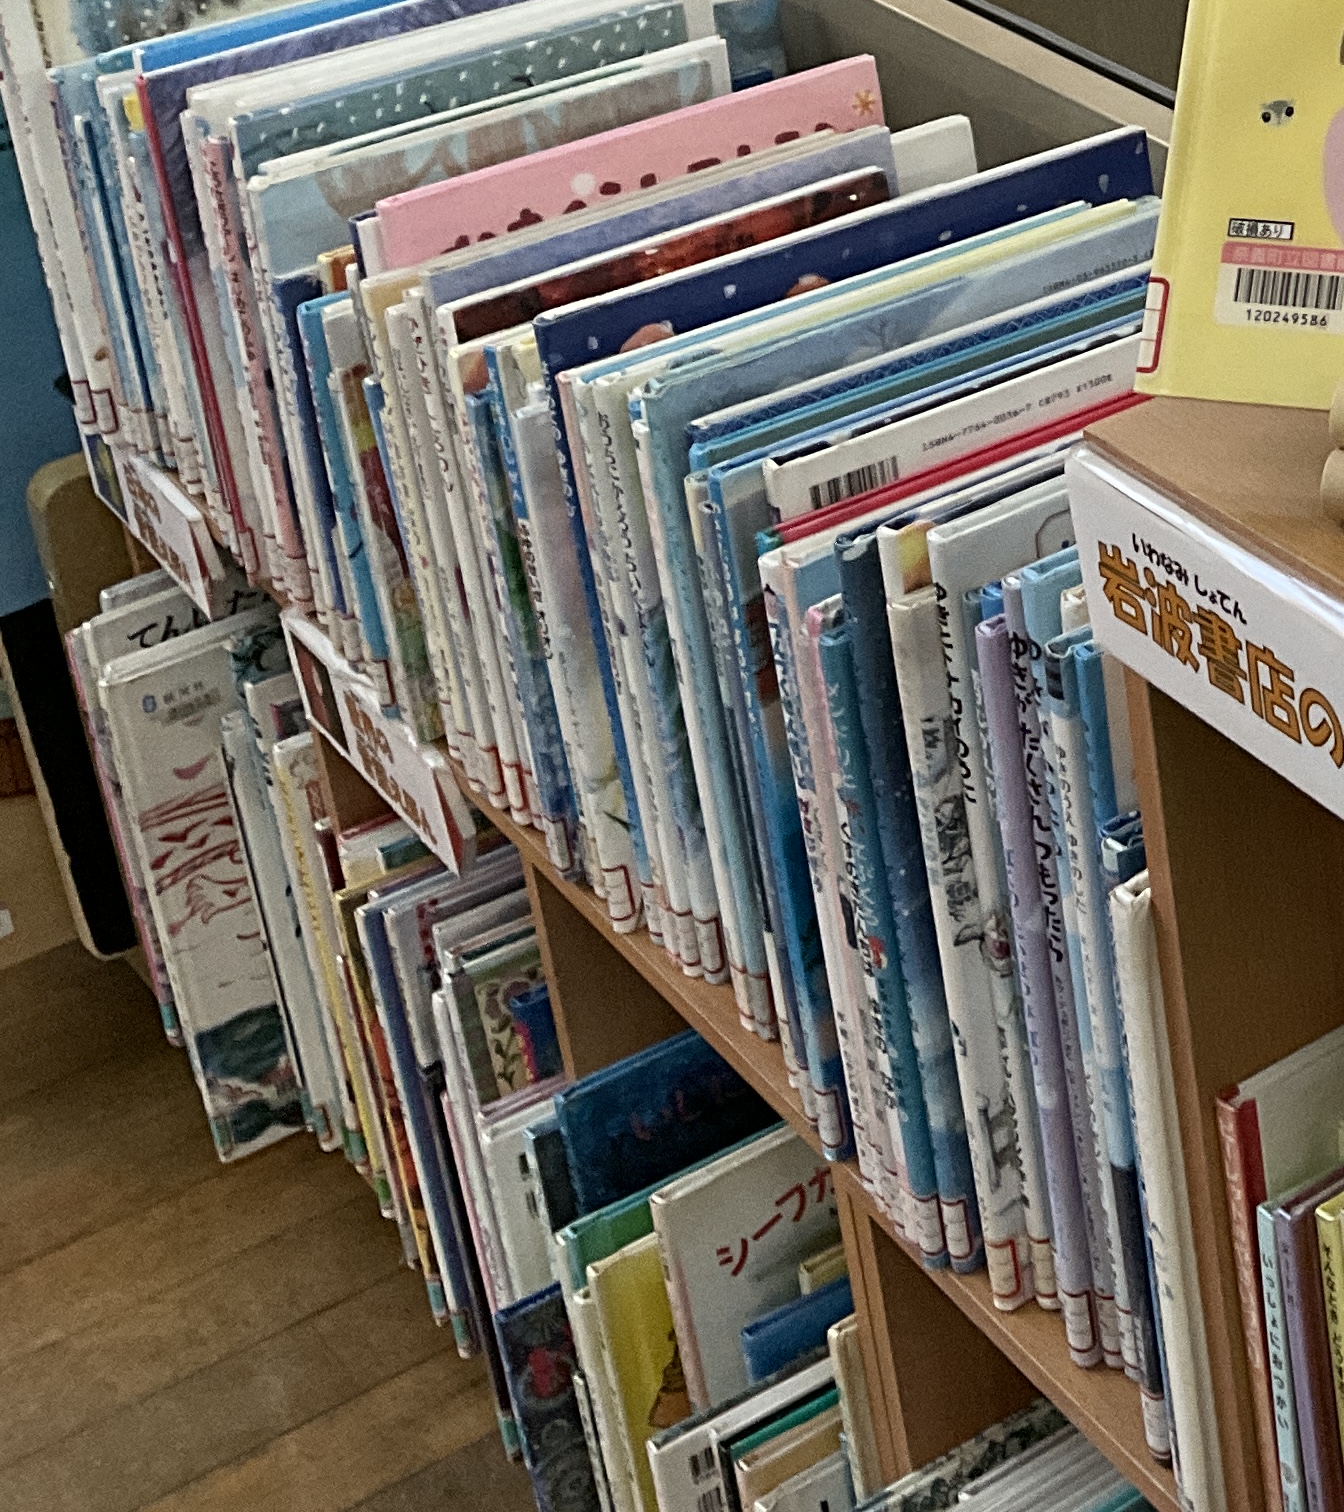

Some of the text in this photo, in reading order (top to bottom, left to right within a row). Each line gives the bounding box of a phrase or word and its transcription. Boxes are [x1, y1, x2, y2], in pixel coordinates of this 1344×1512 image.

[1246, 308, 1328, 327] 120249586
[1131, 532, 1248, 626] いわなみ しょてん
